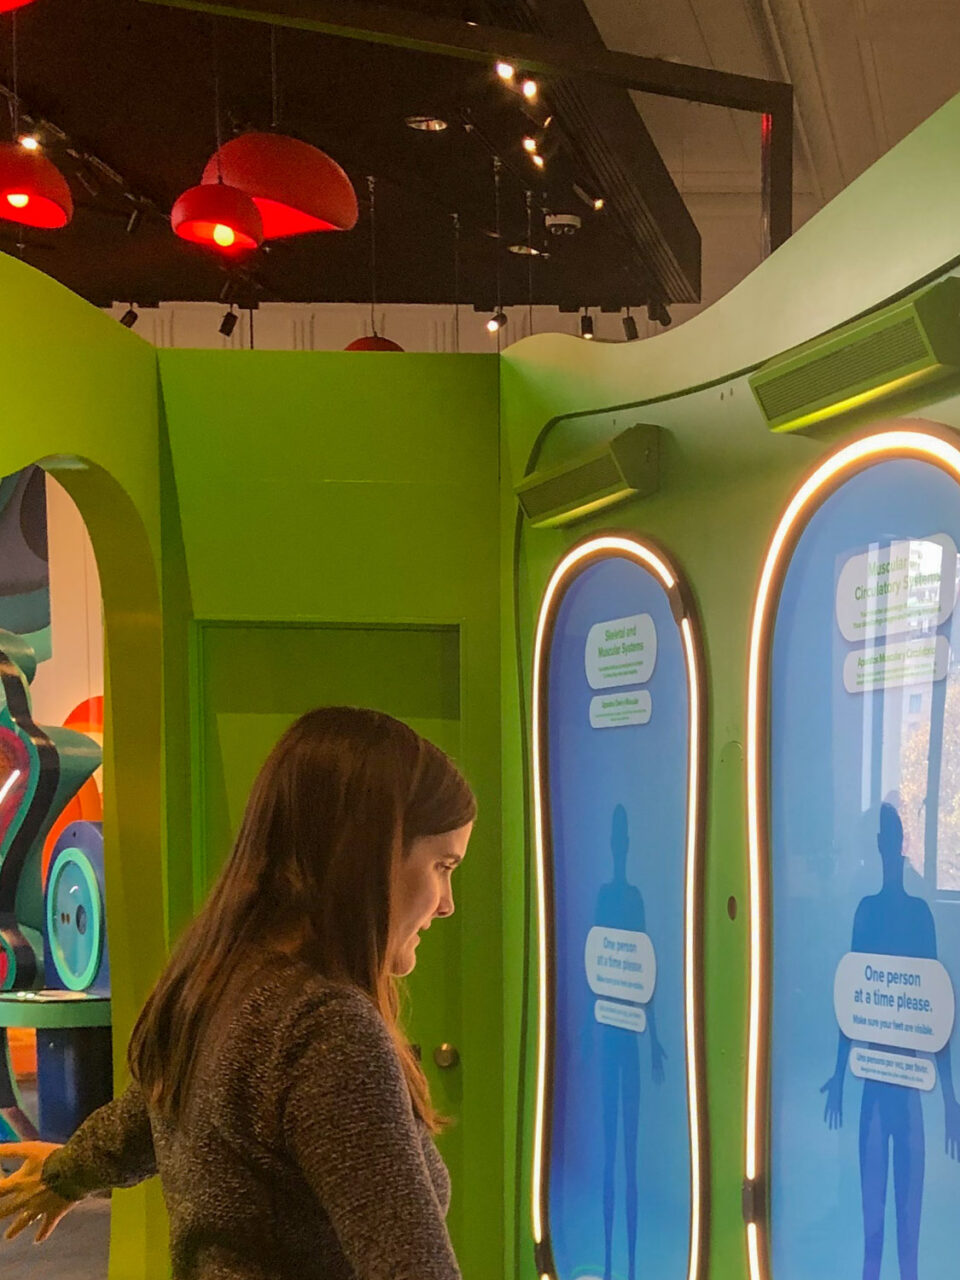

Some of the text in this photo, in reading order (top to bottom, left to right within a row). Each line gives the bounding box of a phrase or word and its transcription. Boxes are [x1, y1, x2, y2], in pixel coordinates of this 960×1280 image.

[855, 580, 901, 602] Circulatory
[865, 965, 921, 988] One person
[854, 988, 933, 1013] at a time please.
